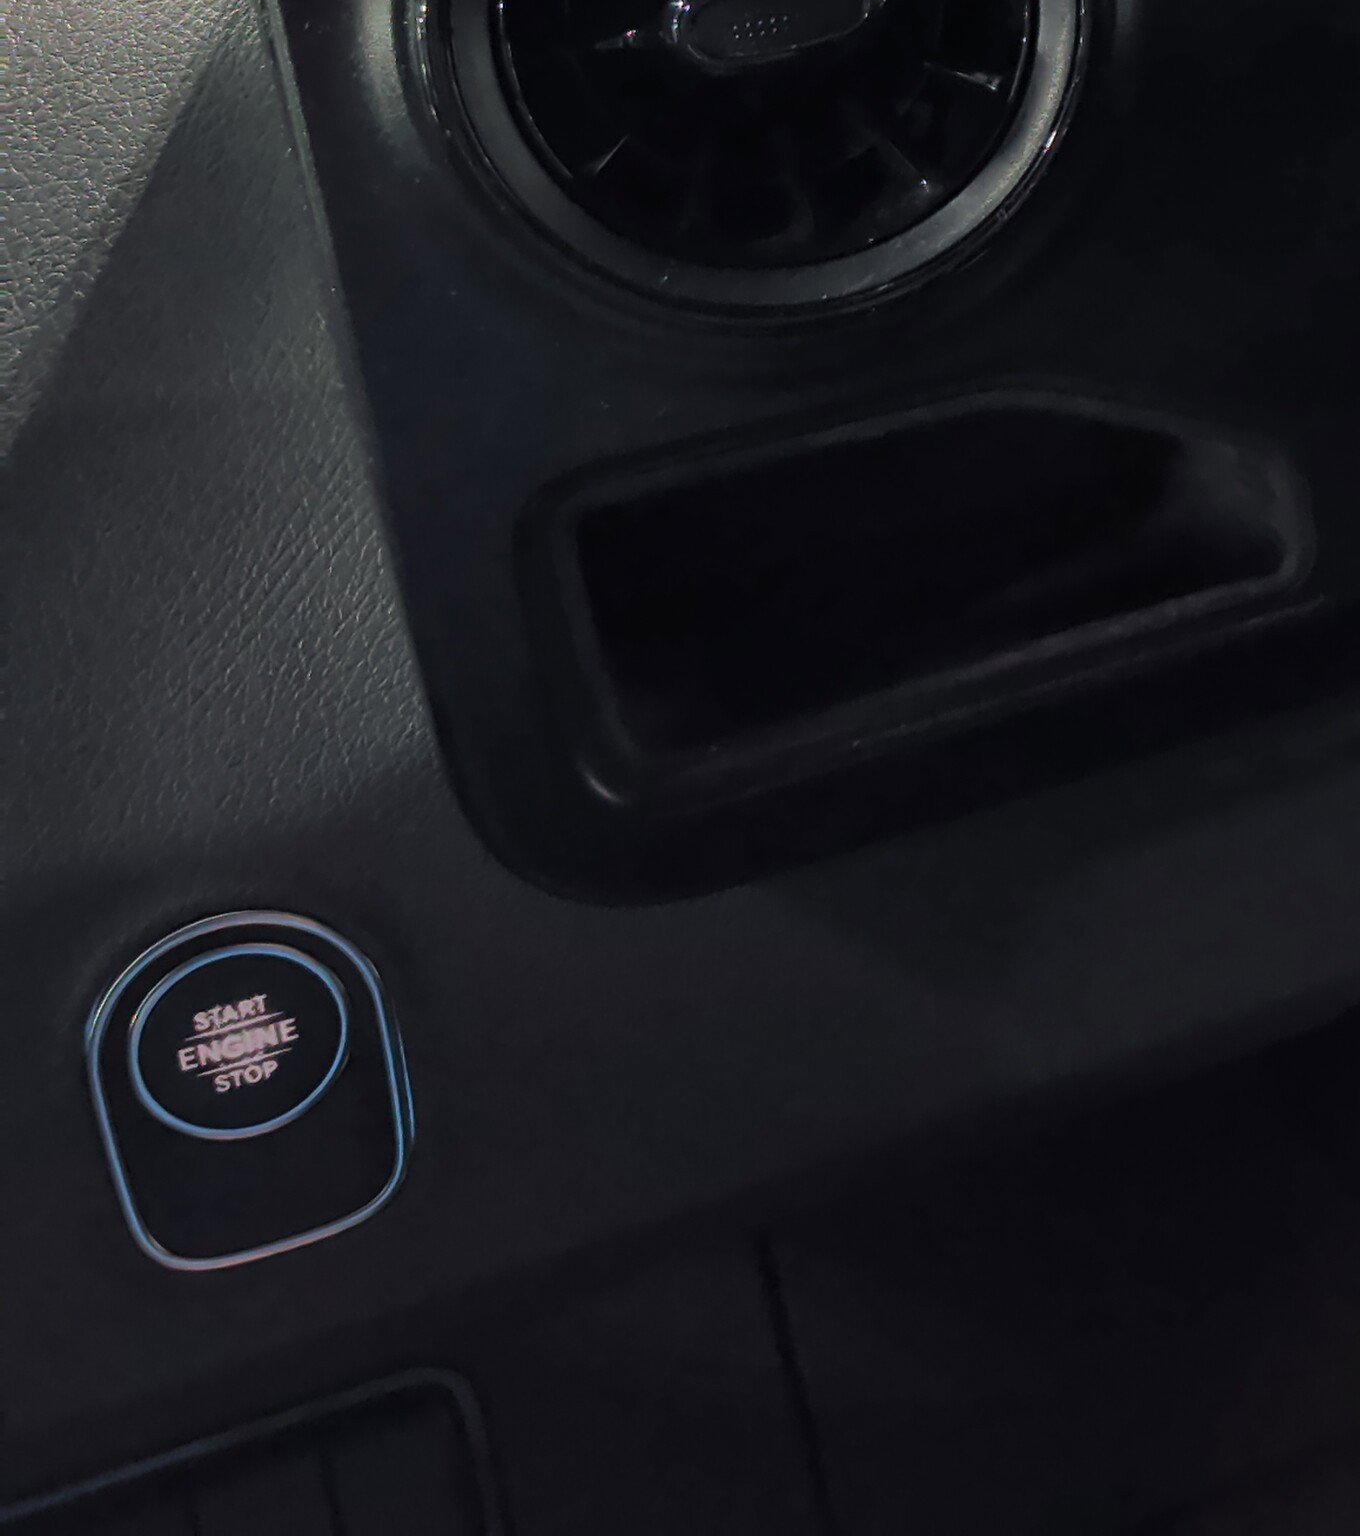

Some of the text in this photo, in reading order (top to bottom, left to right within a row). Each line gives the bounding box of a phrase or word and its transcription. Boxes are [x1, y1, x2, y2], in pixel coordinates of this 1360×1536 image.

[193, 994, 268, 1031] START
[176, 1016, 299, 1072] ENGINE
[214, 1060, 279, 1094] STOP
